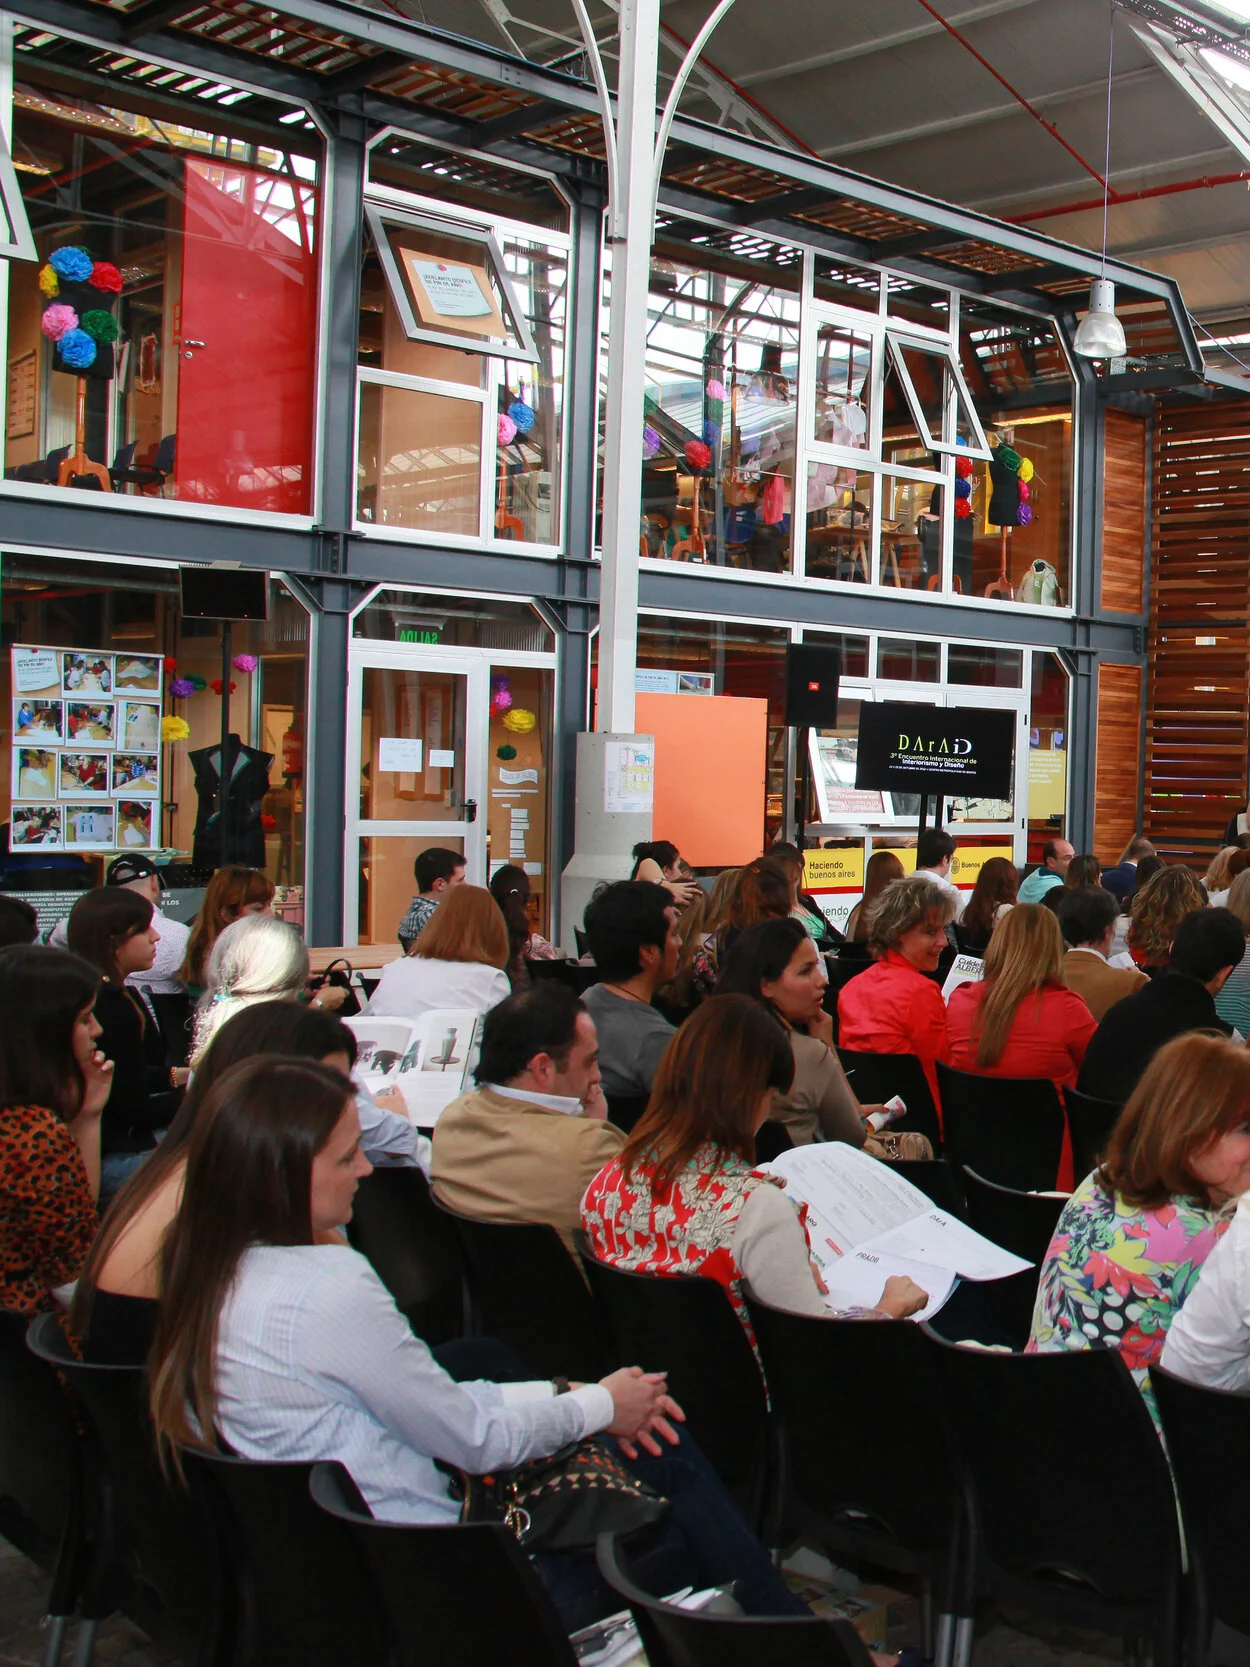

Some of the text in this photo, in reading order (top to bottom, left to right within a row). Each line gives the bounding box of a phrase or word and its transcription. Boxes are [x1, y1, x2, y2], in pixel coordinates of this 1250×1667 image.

[810, 861, 844, 869] Haciendo
[810, 870, 855, 879] buenos aires
[822, 905, 849, 916] iendo
[956, 964, 983, 975] ALBER
